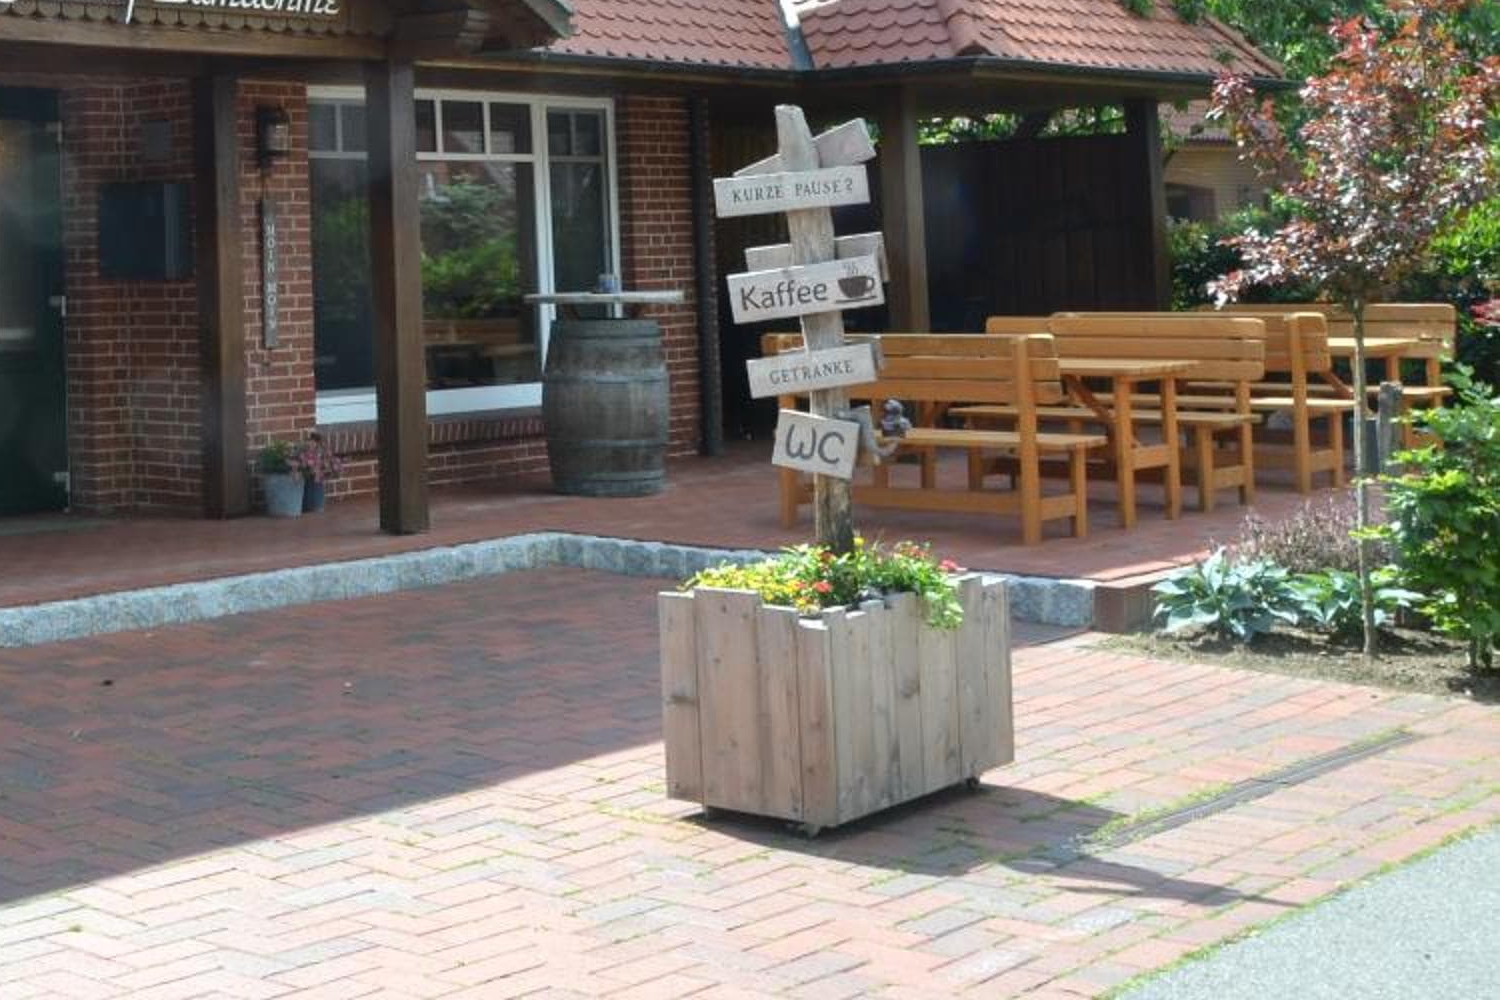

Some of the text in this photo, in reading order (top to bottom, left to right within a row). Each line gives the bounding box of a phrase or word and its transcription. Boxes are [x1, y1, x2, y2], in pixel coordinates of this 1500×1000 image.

[732, 177, 853, 203] KURZE PAUSE?
[740, 279, 828, 311] Kaffee
[785, 423, 845, 464] WC
